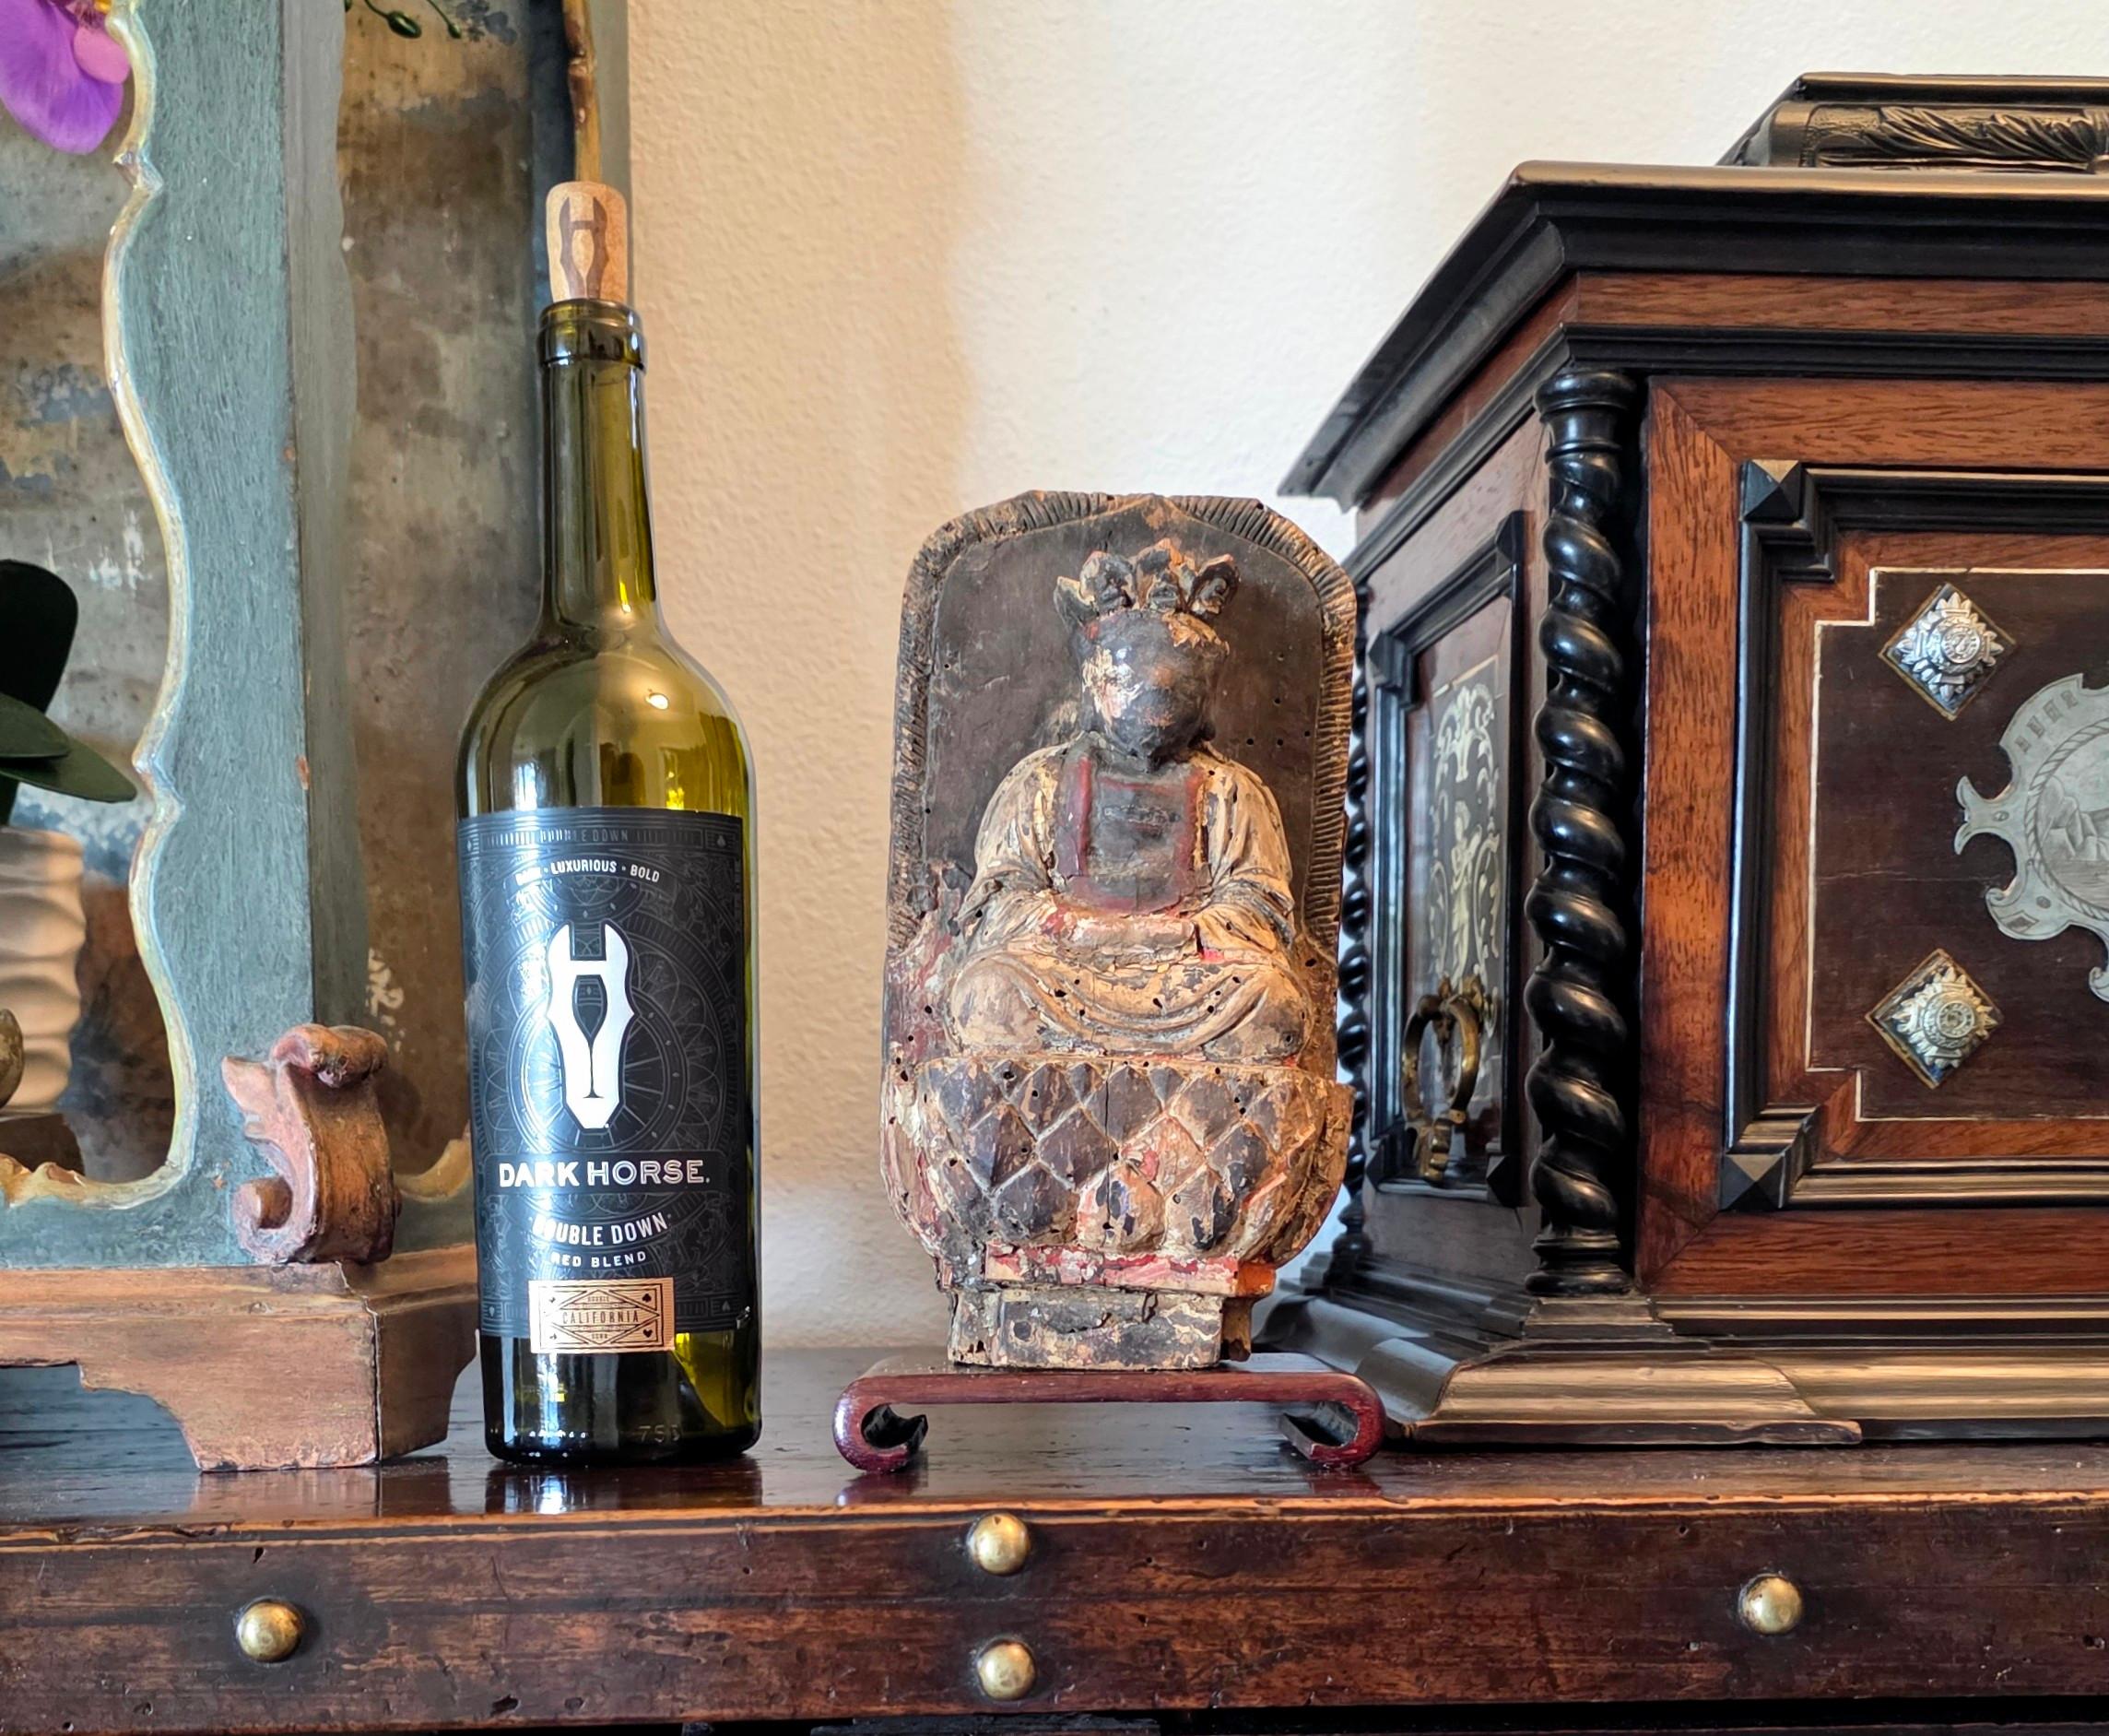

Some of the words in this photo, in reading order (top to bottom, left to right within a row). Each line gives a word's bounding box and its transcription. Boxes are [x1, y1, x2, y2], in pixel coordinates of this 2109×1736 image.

[550, 859, 618, 875] LUXURIOUS
[630, 864, 660, 882] BOLD
[499, 1162, 580, 1187] DARK
[611, 1212, 668, 1245] DOWN
[550, 1251, 582, 1268] RED
[591, 1251, 647, 1269] BLEND
[562, 1310, 640, 1324] CALIFORNIA
